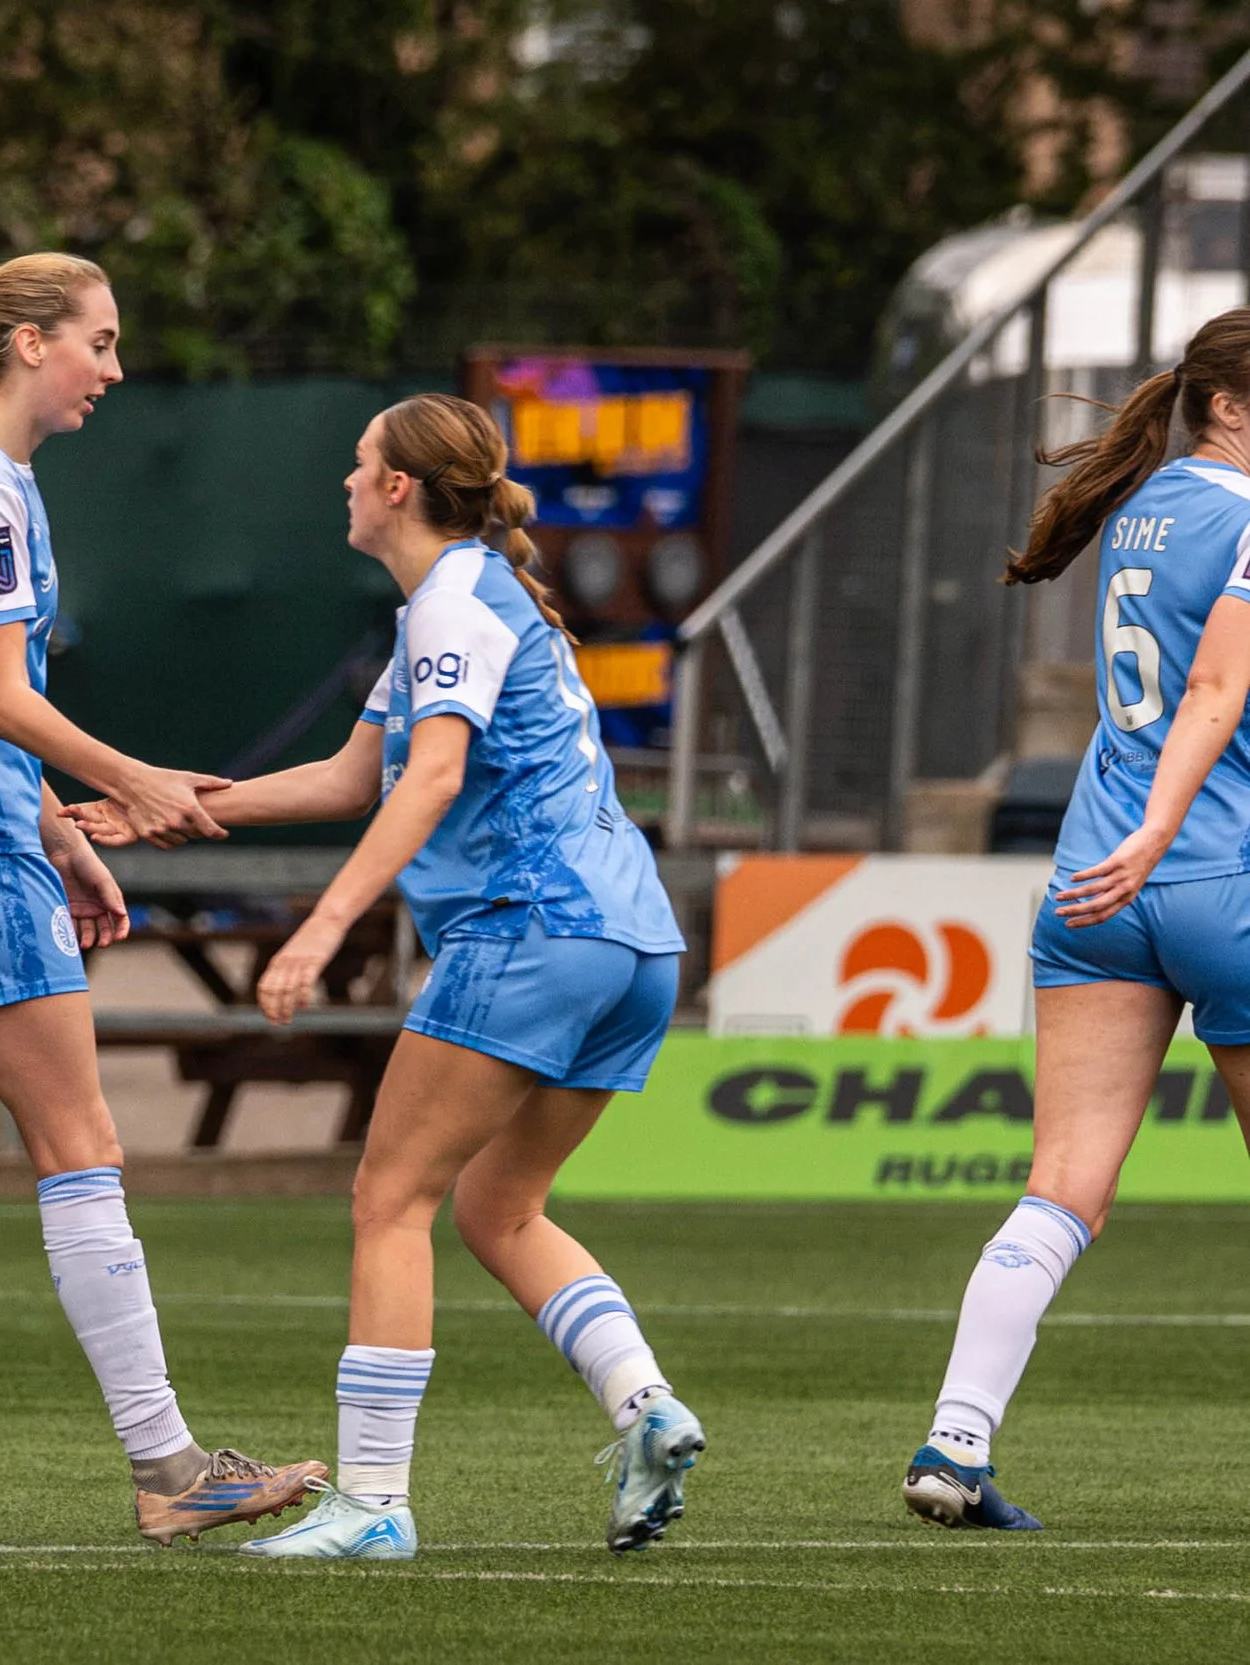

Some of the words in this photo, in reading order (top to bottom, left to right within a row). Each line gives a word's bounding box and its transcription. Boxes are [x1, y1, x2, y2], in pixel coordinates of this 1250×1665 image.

[1111, 516, 1176, 552] SIME
[1102, 566, 1164, 733] 6
[414, 652, 470, 689] ogi
